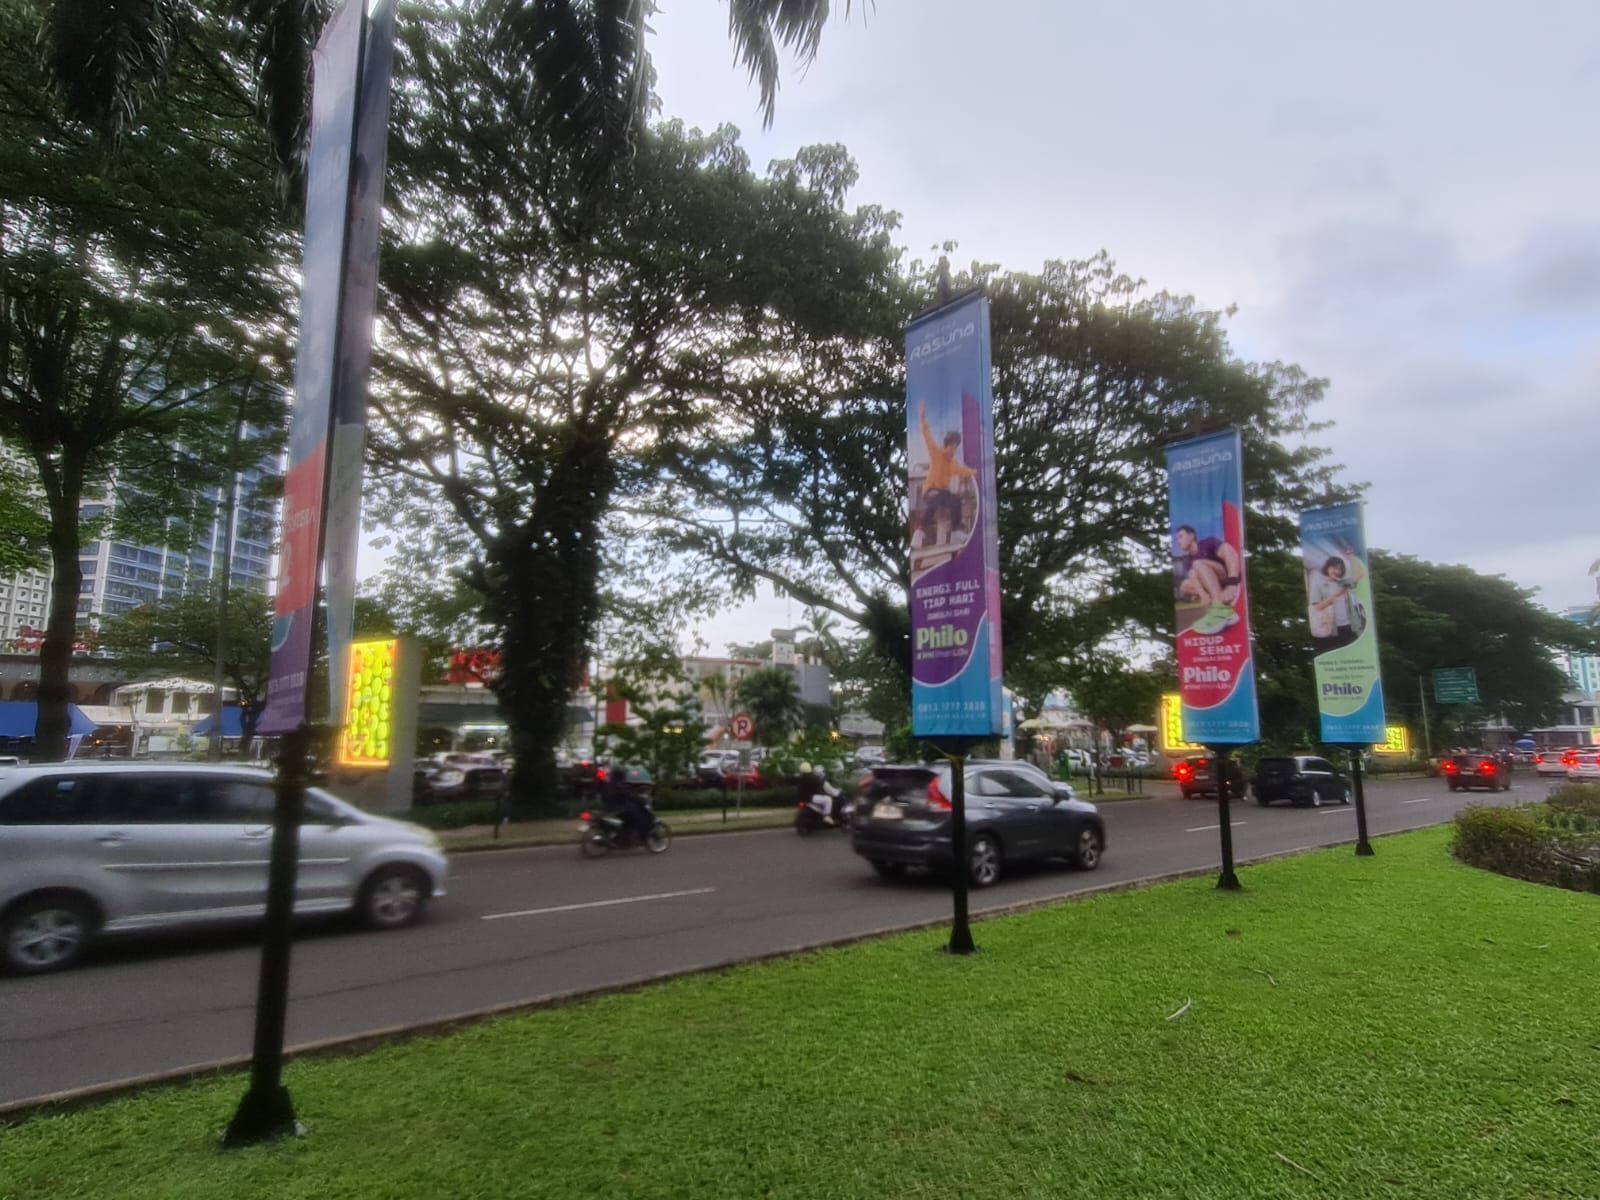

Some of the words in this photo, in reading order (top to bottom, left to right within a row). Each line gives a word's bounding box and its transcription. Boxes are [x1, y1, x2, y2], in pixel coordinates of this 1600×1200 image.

[916, 583, 951, 598] ENERGI
[955, 579, 980, 592] FULL
[923, 597, 946, 609] TIAP
[949, 592, 975, 606] HARI
[916, 624, 968, 651] Philo
[1183, 636, 1224, 647] HIDUP
[1199, 644, 1242, 656] SEHAT
[1183, 666, 1231, 683] Philo
[1322, 682, 1362, 696] Philo
